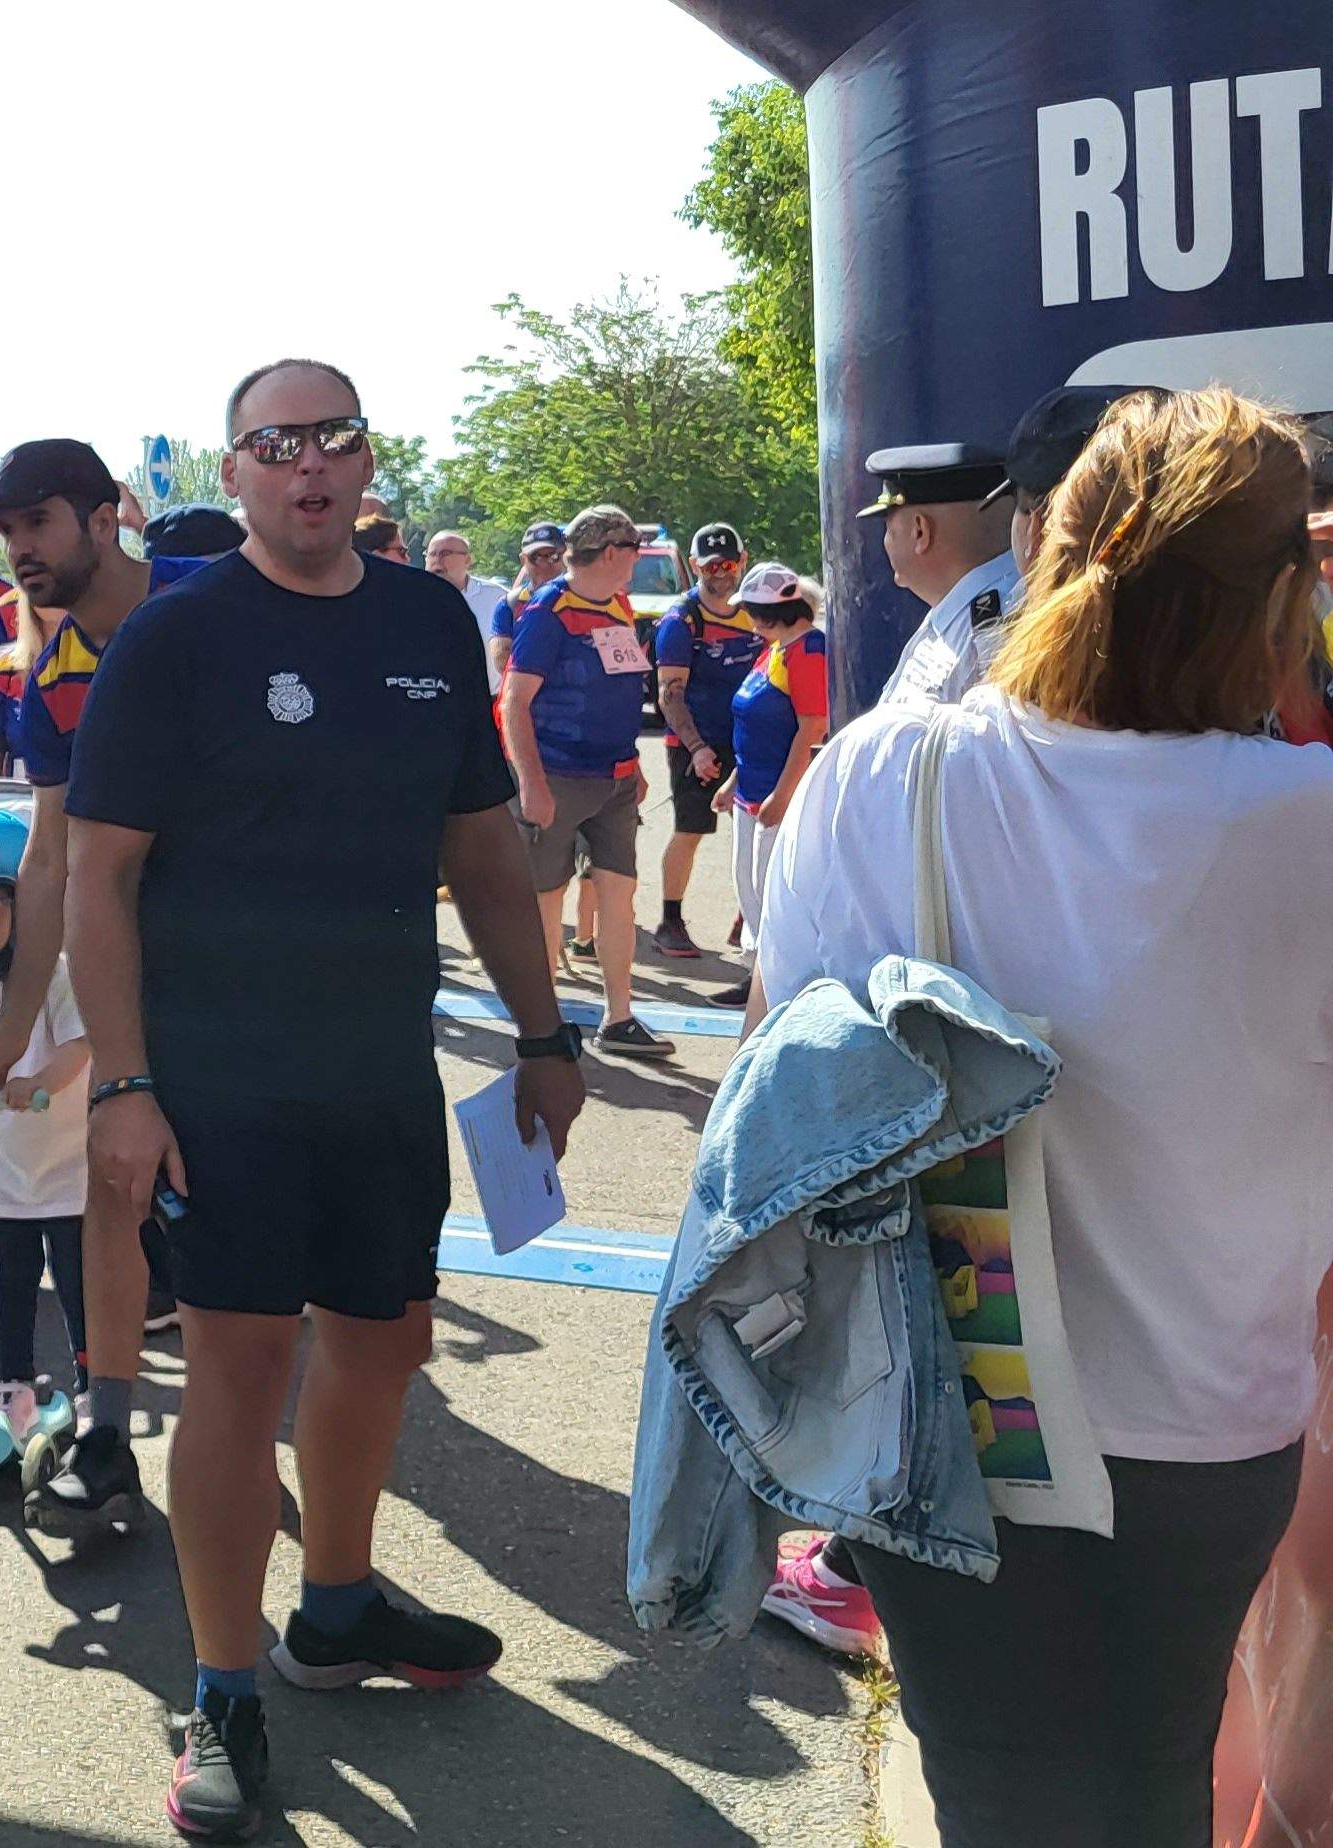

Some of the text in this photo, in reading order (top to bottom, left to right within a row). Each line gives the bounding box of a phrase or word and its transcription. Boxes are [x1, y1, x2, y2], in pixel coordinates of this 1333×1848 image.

[1037, 68, 1333, 307] RUT
[385, 678, 444, 689] POLICIA
[407, 690, 436, 699] CNP
